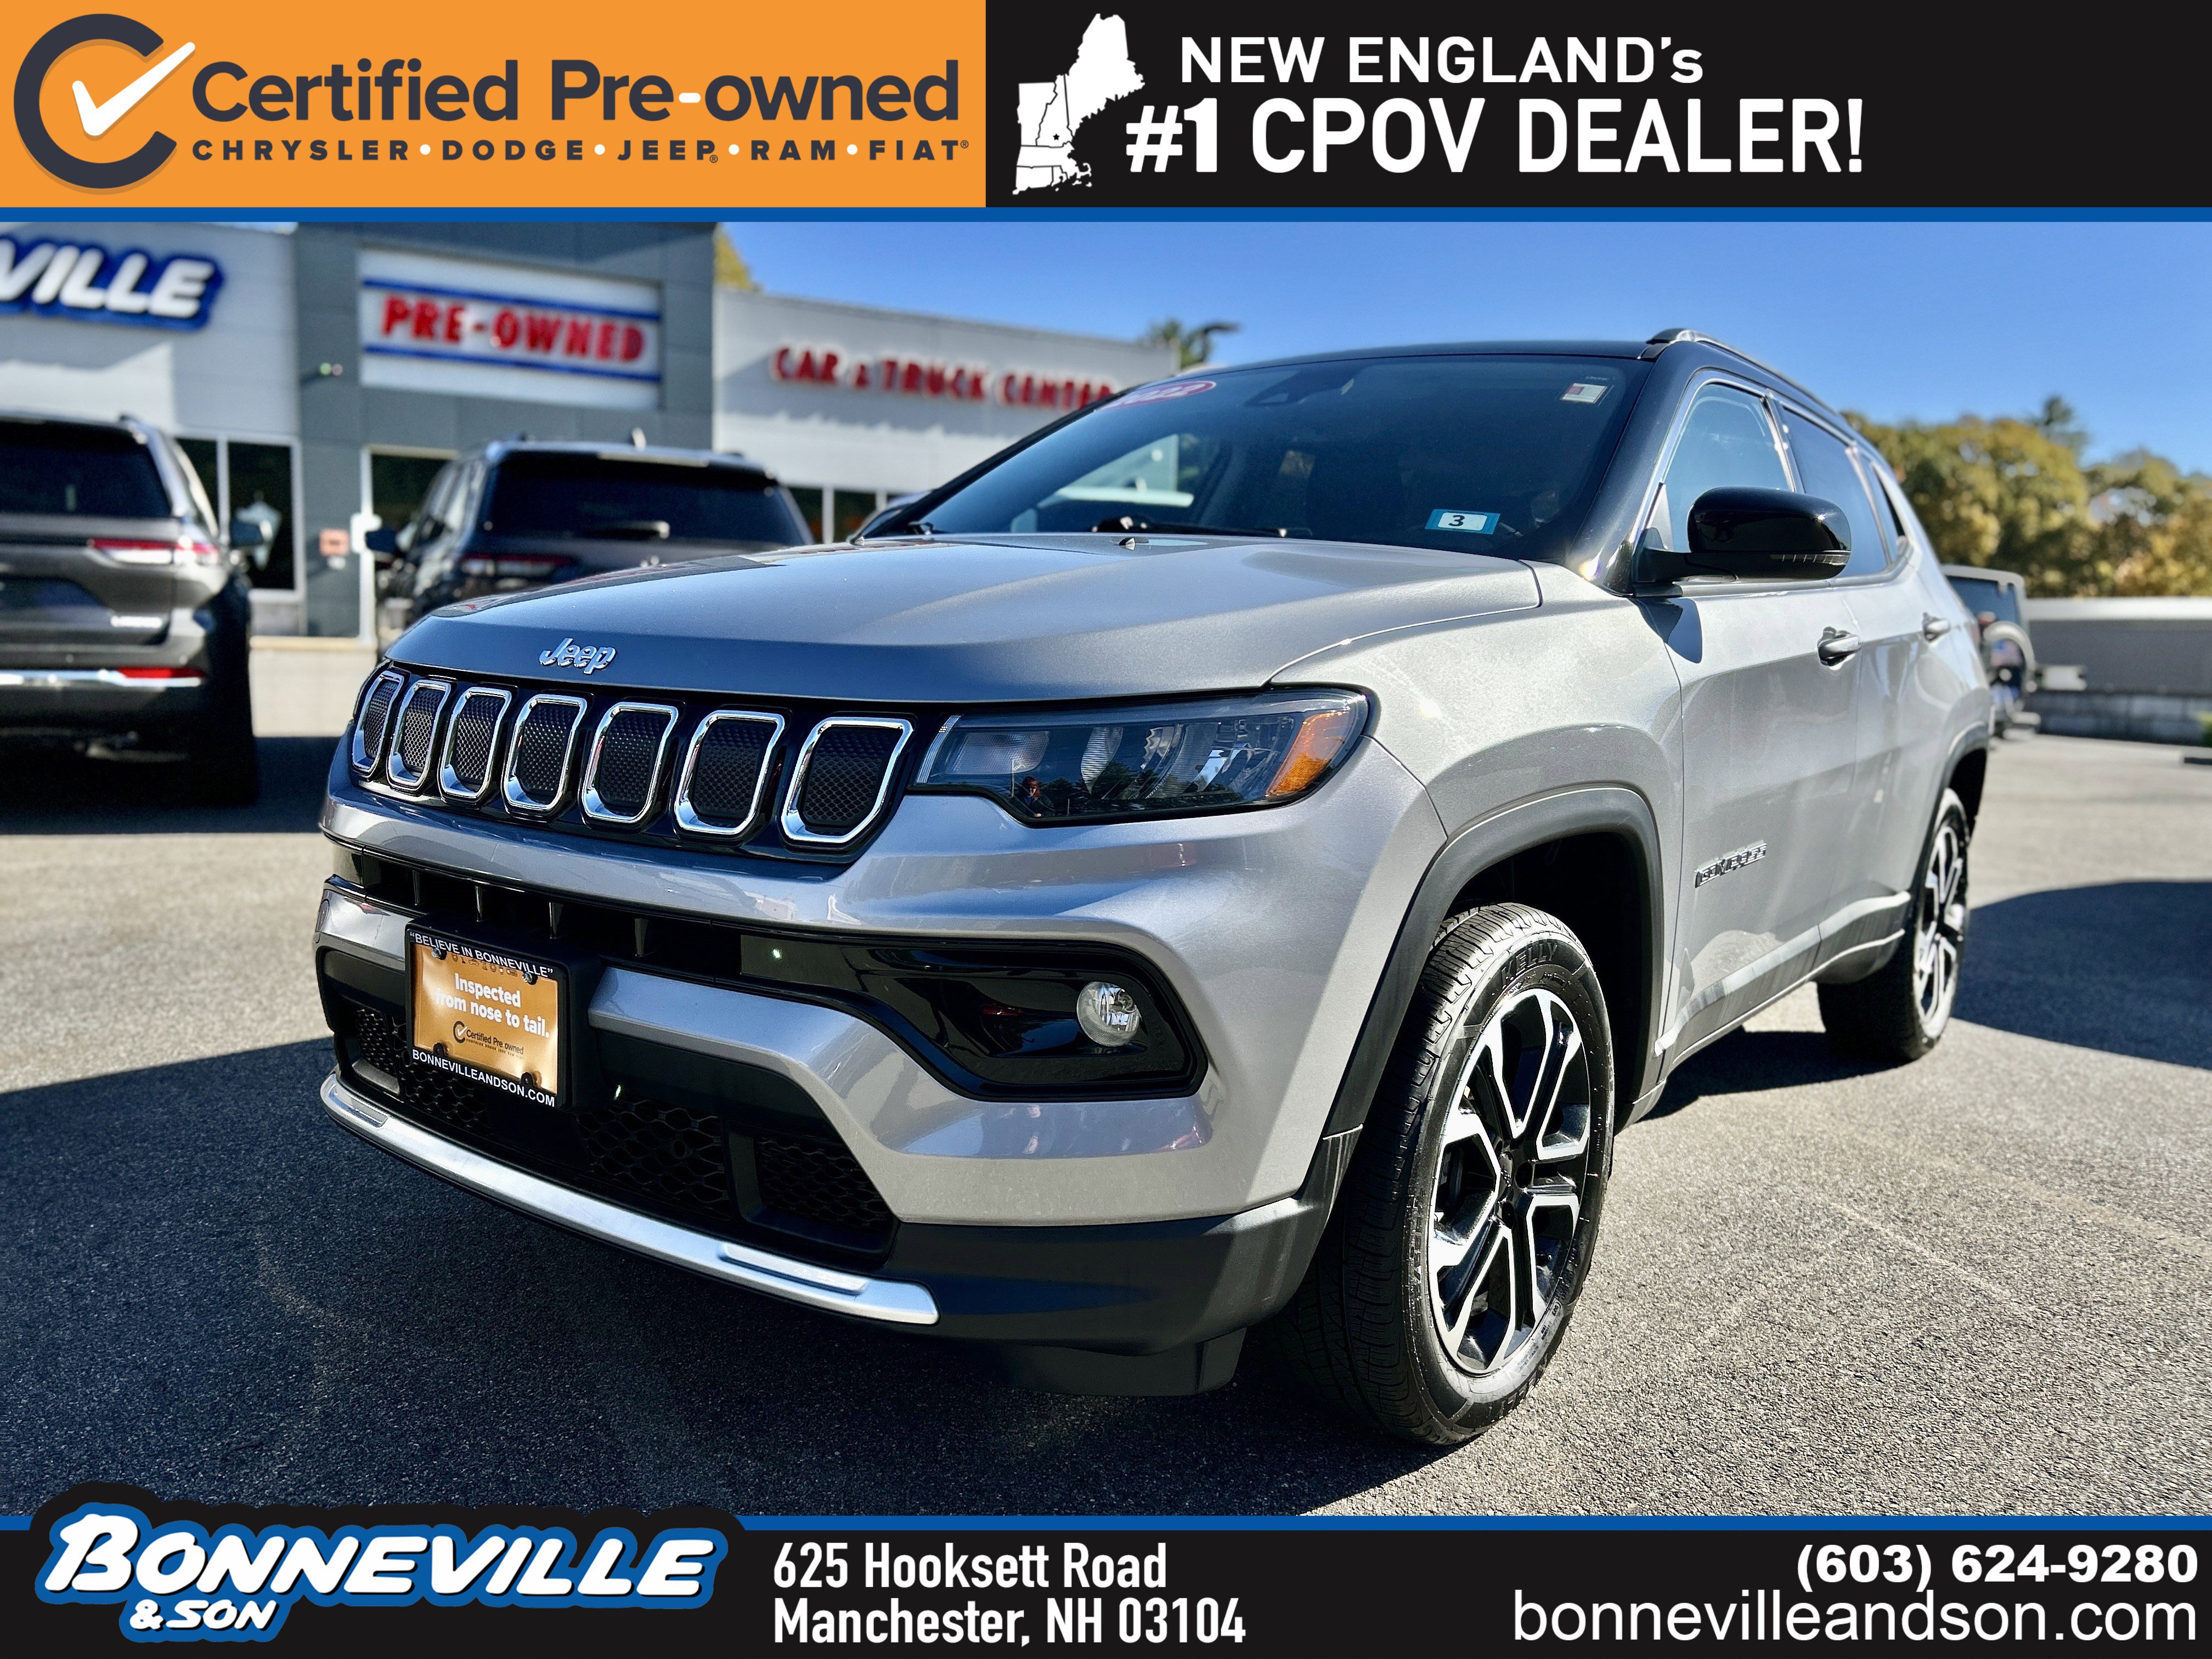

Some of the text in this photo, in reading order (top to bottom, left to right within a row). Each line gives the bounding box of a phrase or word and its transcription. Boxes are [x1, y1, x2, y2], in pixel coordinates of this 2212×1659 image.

[0, 238, 215, 318] VILLE
[382, 295, 645, 364] PRE-OWNED
[772, 347, 839, 384] CAR
[880, 359, 983, 402] TRUCK
[1448, 515, 1465, 527] 3
[539, 637, 618, 675] Jeep
[461, 946, 473, 958] IN
[1501, 941, 1558, 989] KELLY
[435, 988, 550, 1038] from nose to tail.
[454, 973, 521, 1007] Inspected
[466, 1029, 492, 1044] Certified
[412, 1048, 555, 1107] BONNEVILLEANDSON.COM
